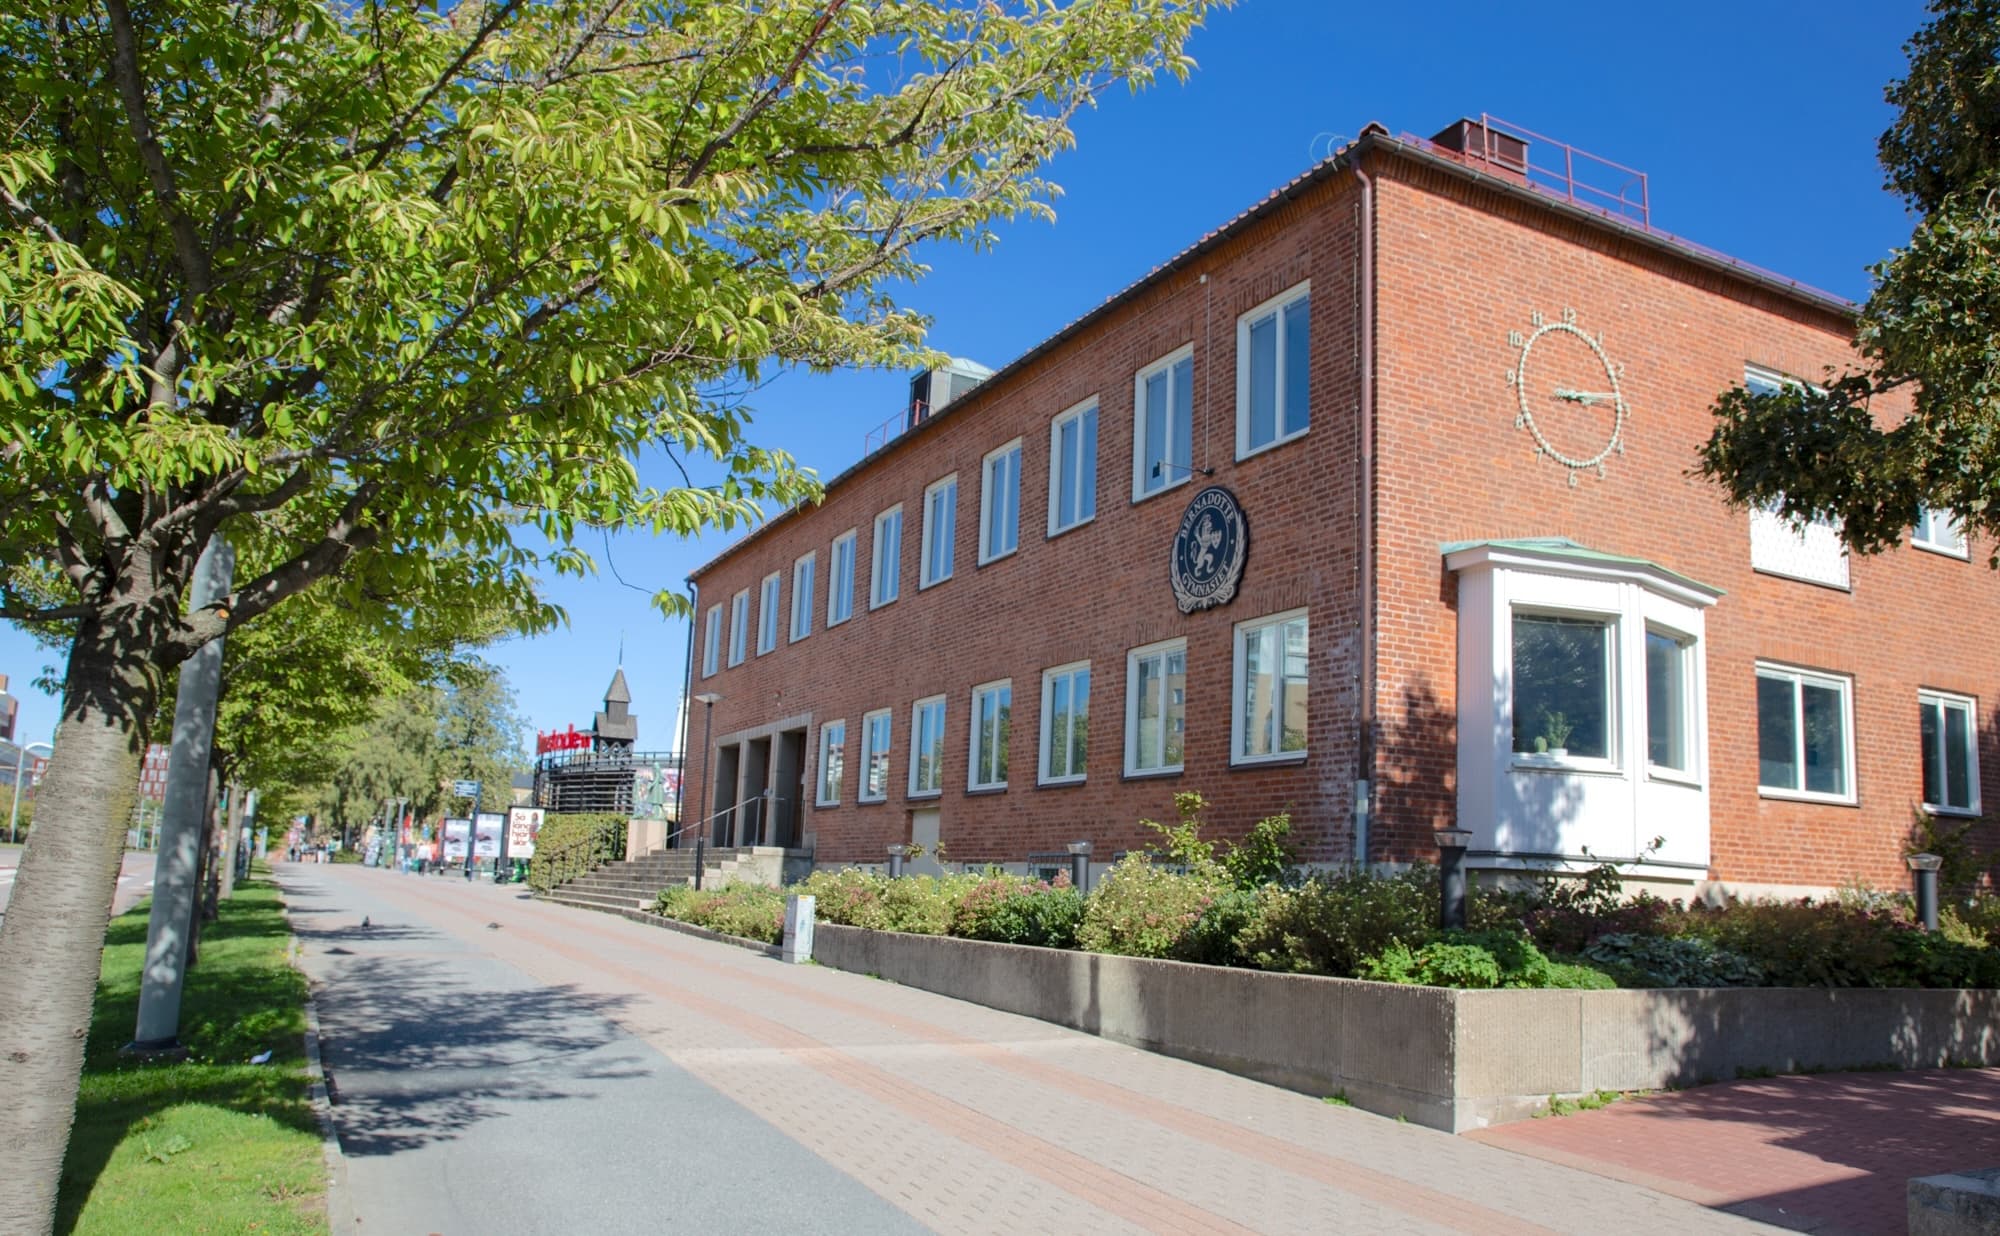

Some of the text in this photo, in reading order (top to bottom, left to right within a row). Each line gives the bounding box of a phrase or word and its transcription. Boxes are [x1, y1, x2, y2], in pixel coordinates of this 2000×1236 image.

[1531, 310, 1543, 325] 11
[1563, 308, 1577, 323] 12
[1508, 331, 1523, 346] 10
[1597, 331, 1604, 344] 1
[1506, 370, 1516, 385] 9
[1617, 364, 1625, 379] 2
[1622, 402, 1631, 418] 3
[1515, 415, 1524, 429] 8
[1617, 440, 1625, 454] 4
[1534, 448, 1543, 464] 7
[1568, 472, 1577, 487] 6
[1597, 465, 1606, 481] 5
[1181, 493, 1235, 539] BERNADOTTE
[1182, 561, 1230, 597] GYMNASIET
